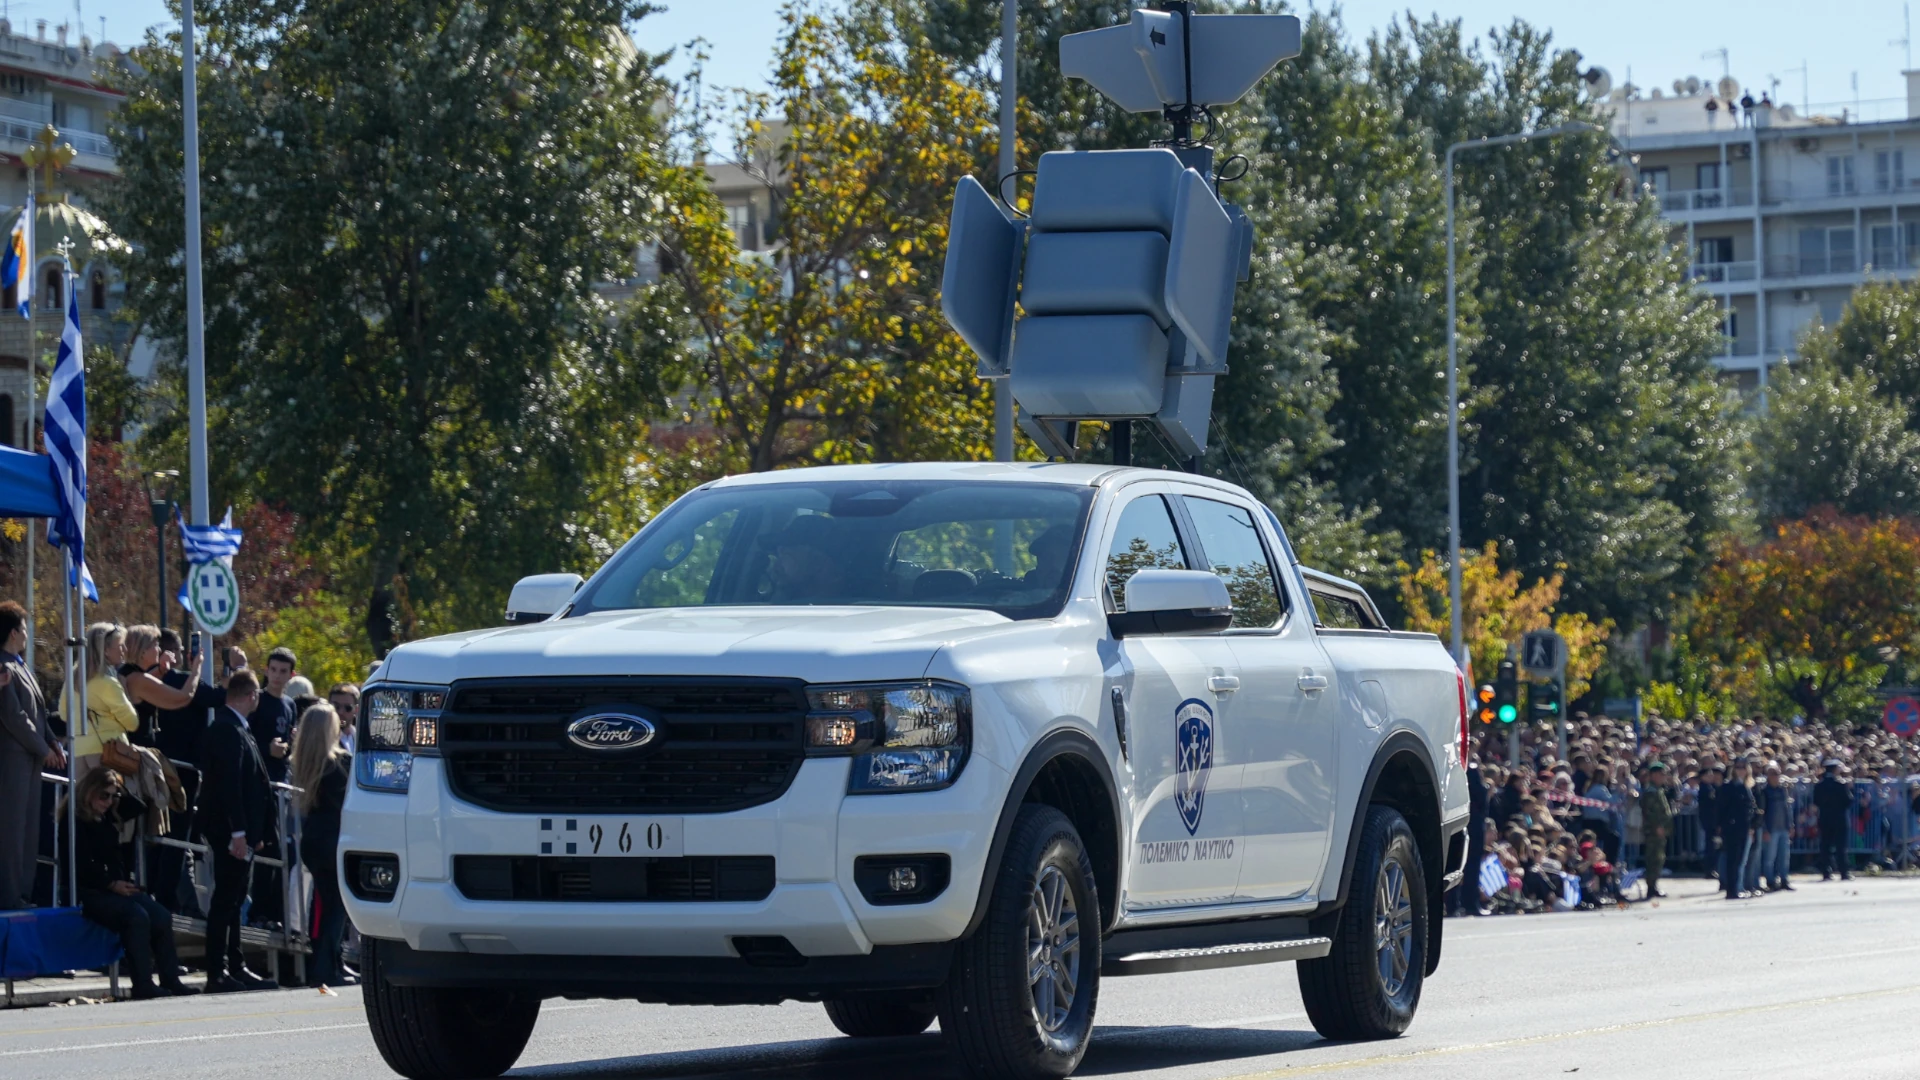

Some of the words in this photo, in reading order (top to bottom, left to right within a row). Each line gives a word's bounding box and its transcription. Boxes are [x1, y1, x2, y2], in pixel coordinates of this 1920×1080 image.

[587, 720, 634, 742] Ford
[589, 822, 662, 854] 960
[1140, 841, 1189, 864] ΠΟΛΕΜΙΚΟ
[1193, 839, 1234, 861] ΝΑΥΤΙΚΟ
